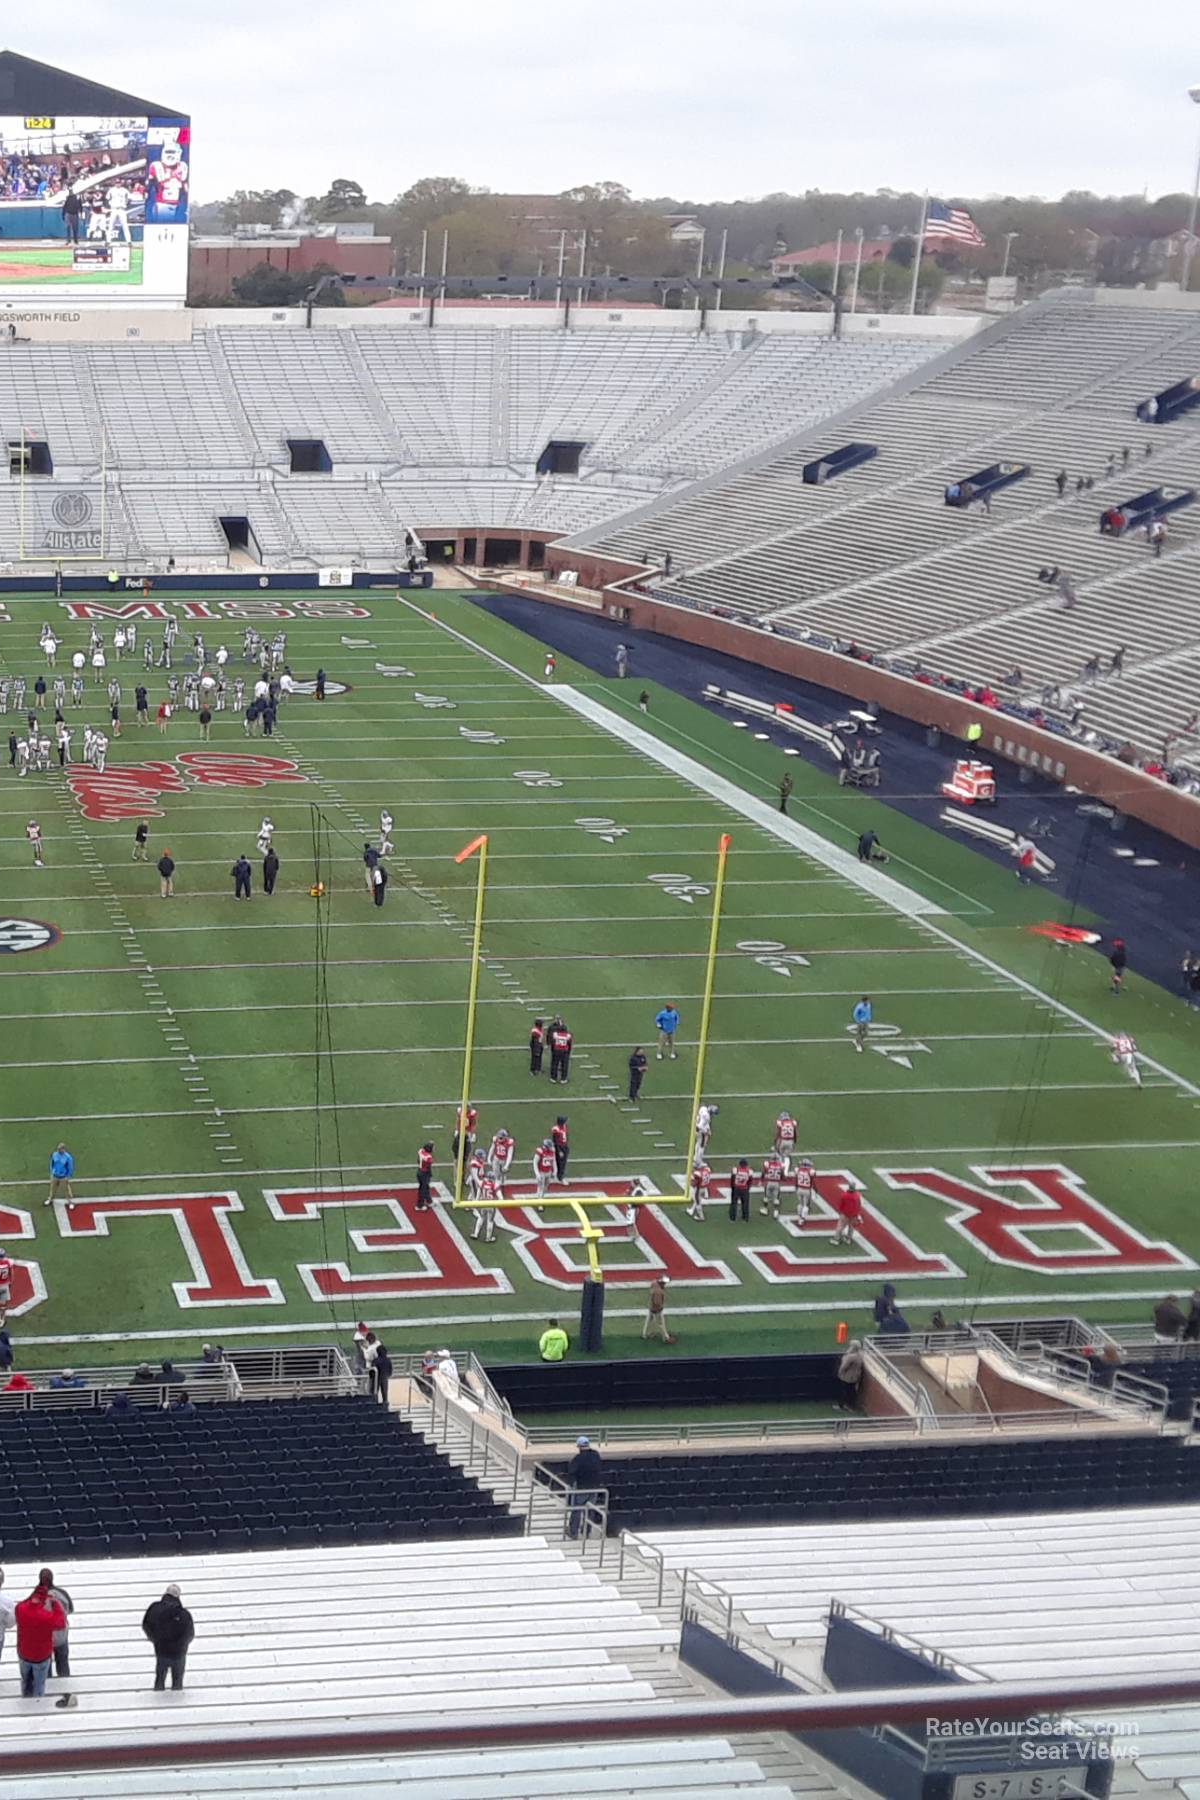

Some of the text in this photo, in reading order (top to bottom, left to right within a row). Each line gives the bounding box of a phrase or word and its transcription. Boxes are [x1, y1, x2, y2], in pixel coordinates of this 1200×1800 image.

[53, 313, 80, 322] FIELD
[44, 531, 101, 548] Allstate
[59, 601, 371, 620] MISS
[512, 770, 564, 788] 50
[647, 873, 712, 897] 30
[735, 940, 811, 967] 20
[846, 1022, 933, 1056] 10
[973, 1778, 1010, 1799] S-7
